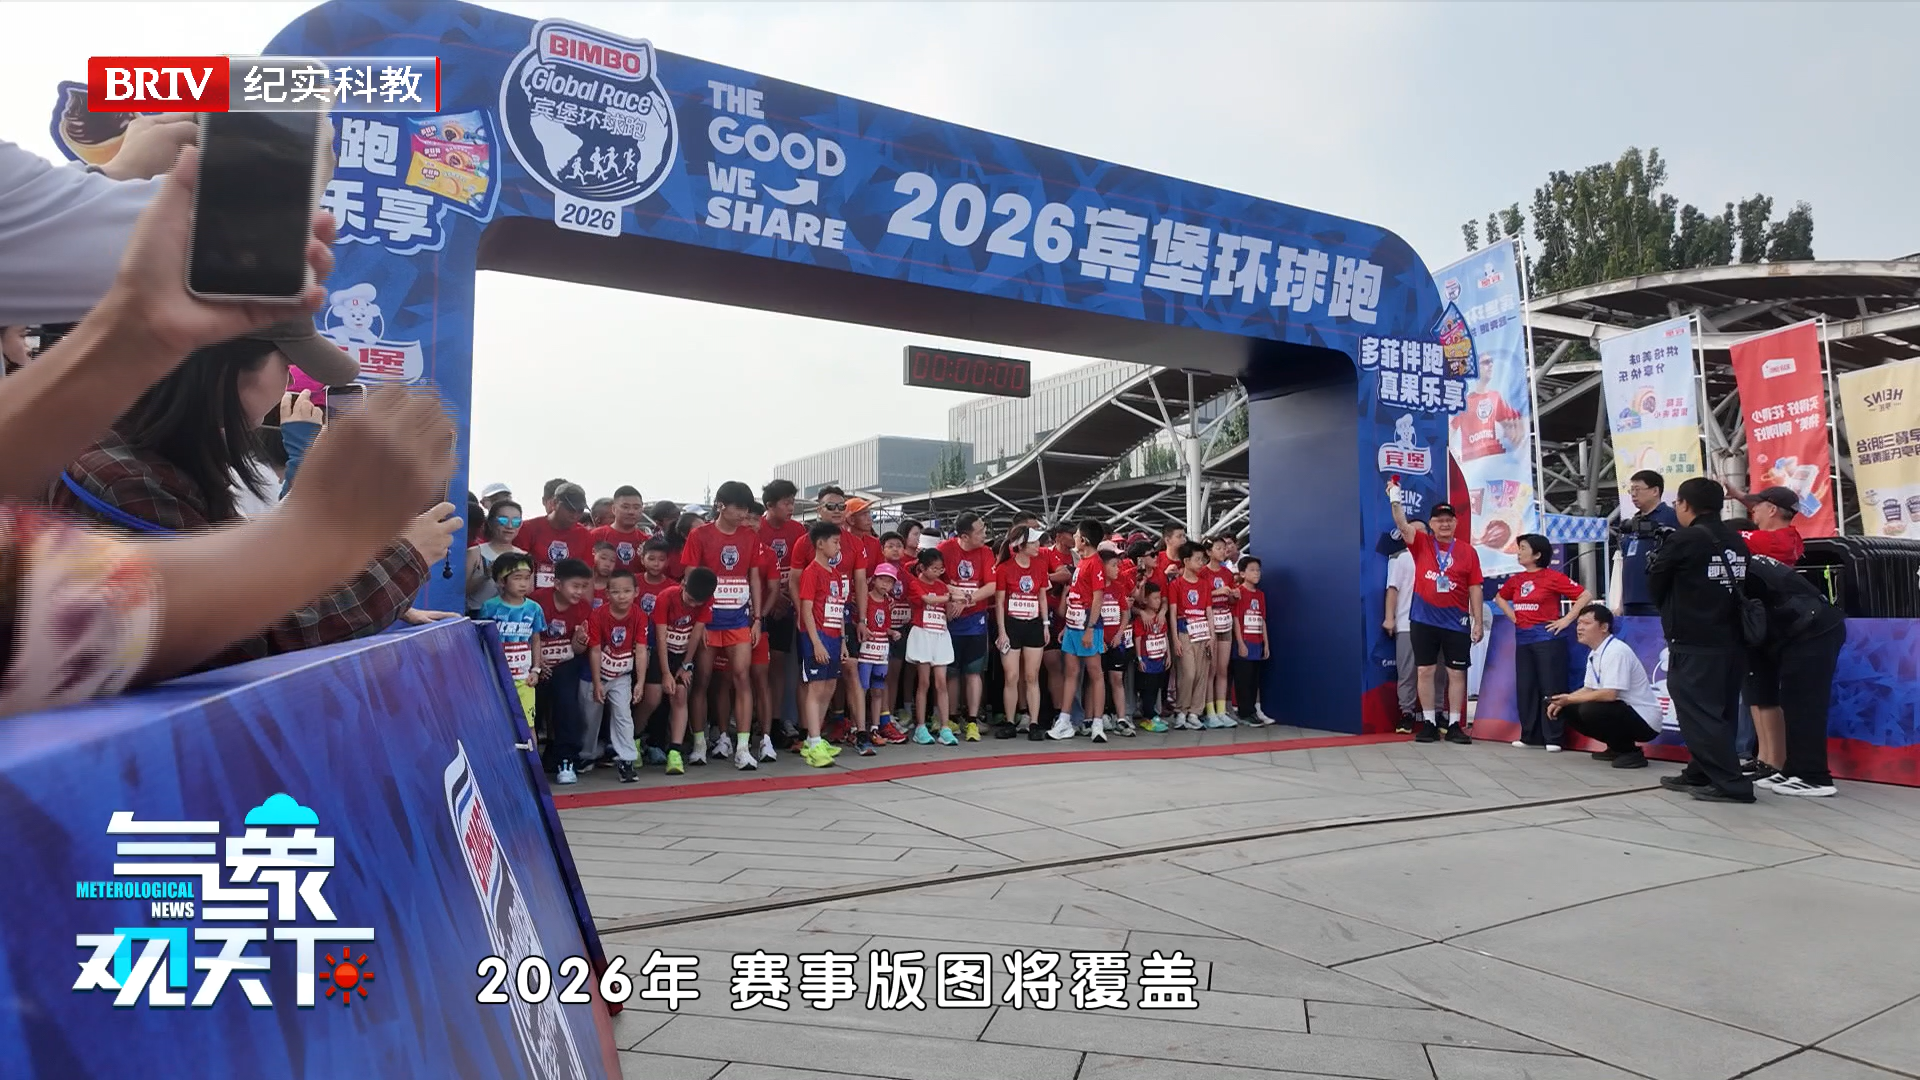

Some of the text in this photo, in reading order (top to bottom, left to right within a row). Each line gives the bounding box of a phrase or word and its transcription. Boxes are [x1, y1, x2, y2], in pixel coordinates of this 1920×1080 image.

[549, 33, 641, 75] BIMBO
[532, 67, 651, 115] Global Race
[708, 79, 765, 120] THE
[531, 96, 648, 142] 宾堡环球跑
[708, 115, 847, 177] GOOD
[707, 160, 757, 199] WE
[561, 203, 616, 231] 2026
[705, 196, 847, 251] SHARE
[886, 171, 1384, 325] 2026宾堡环球跑
[912, 351, 1026, 391] 00:00:00
[1361, 336, 1444, 376] 多菲伴跑
[1380, 370, 1465, 411] 真果乐享
[1385, 450, 1425, 469] 宾堡
[1399, 490, 1423, 507] EINZ
